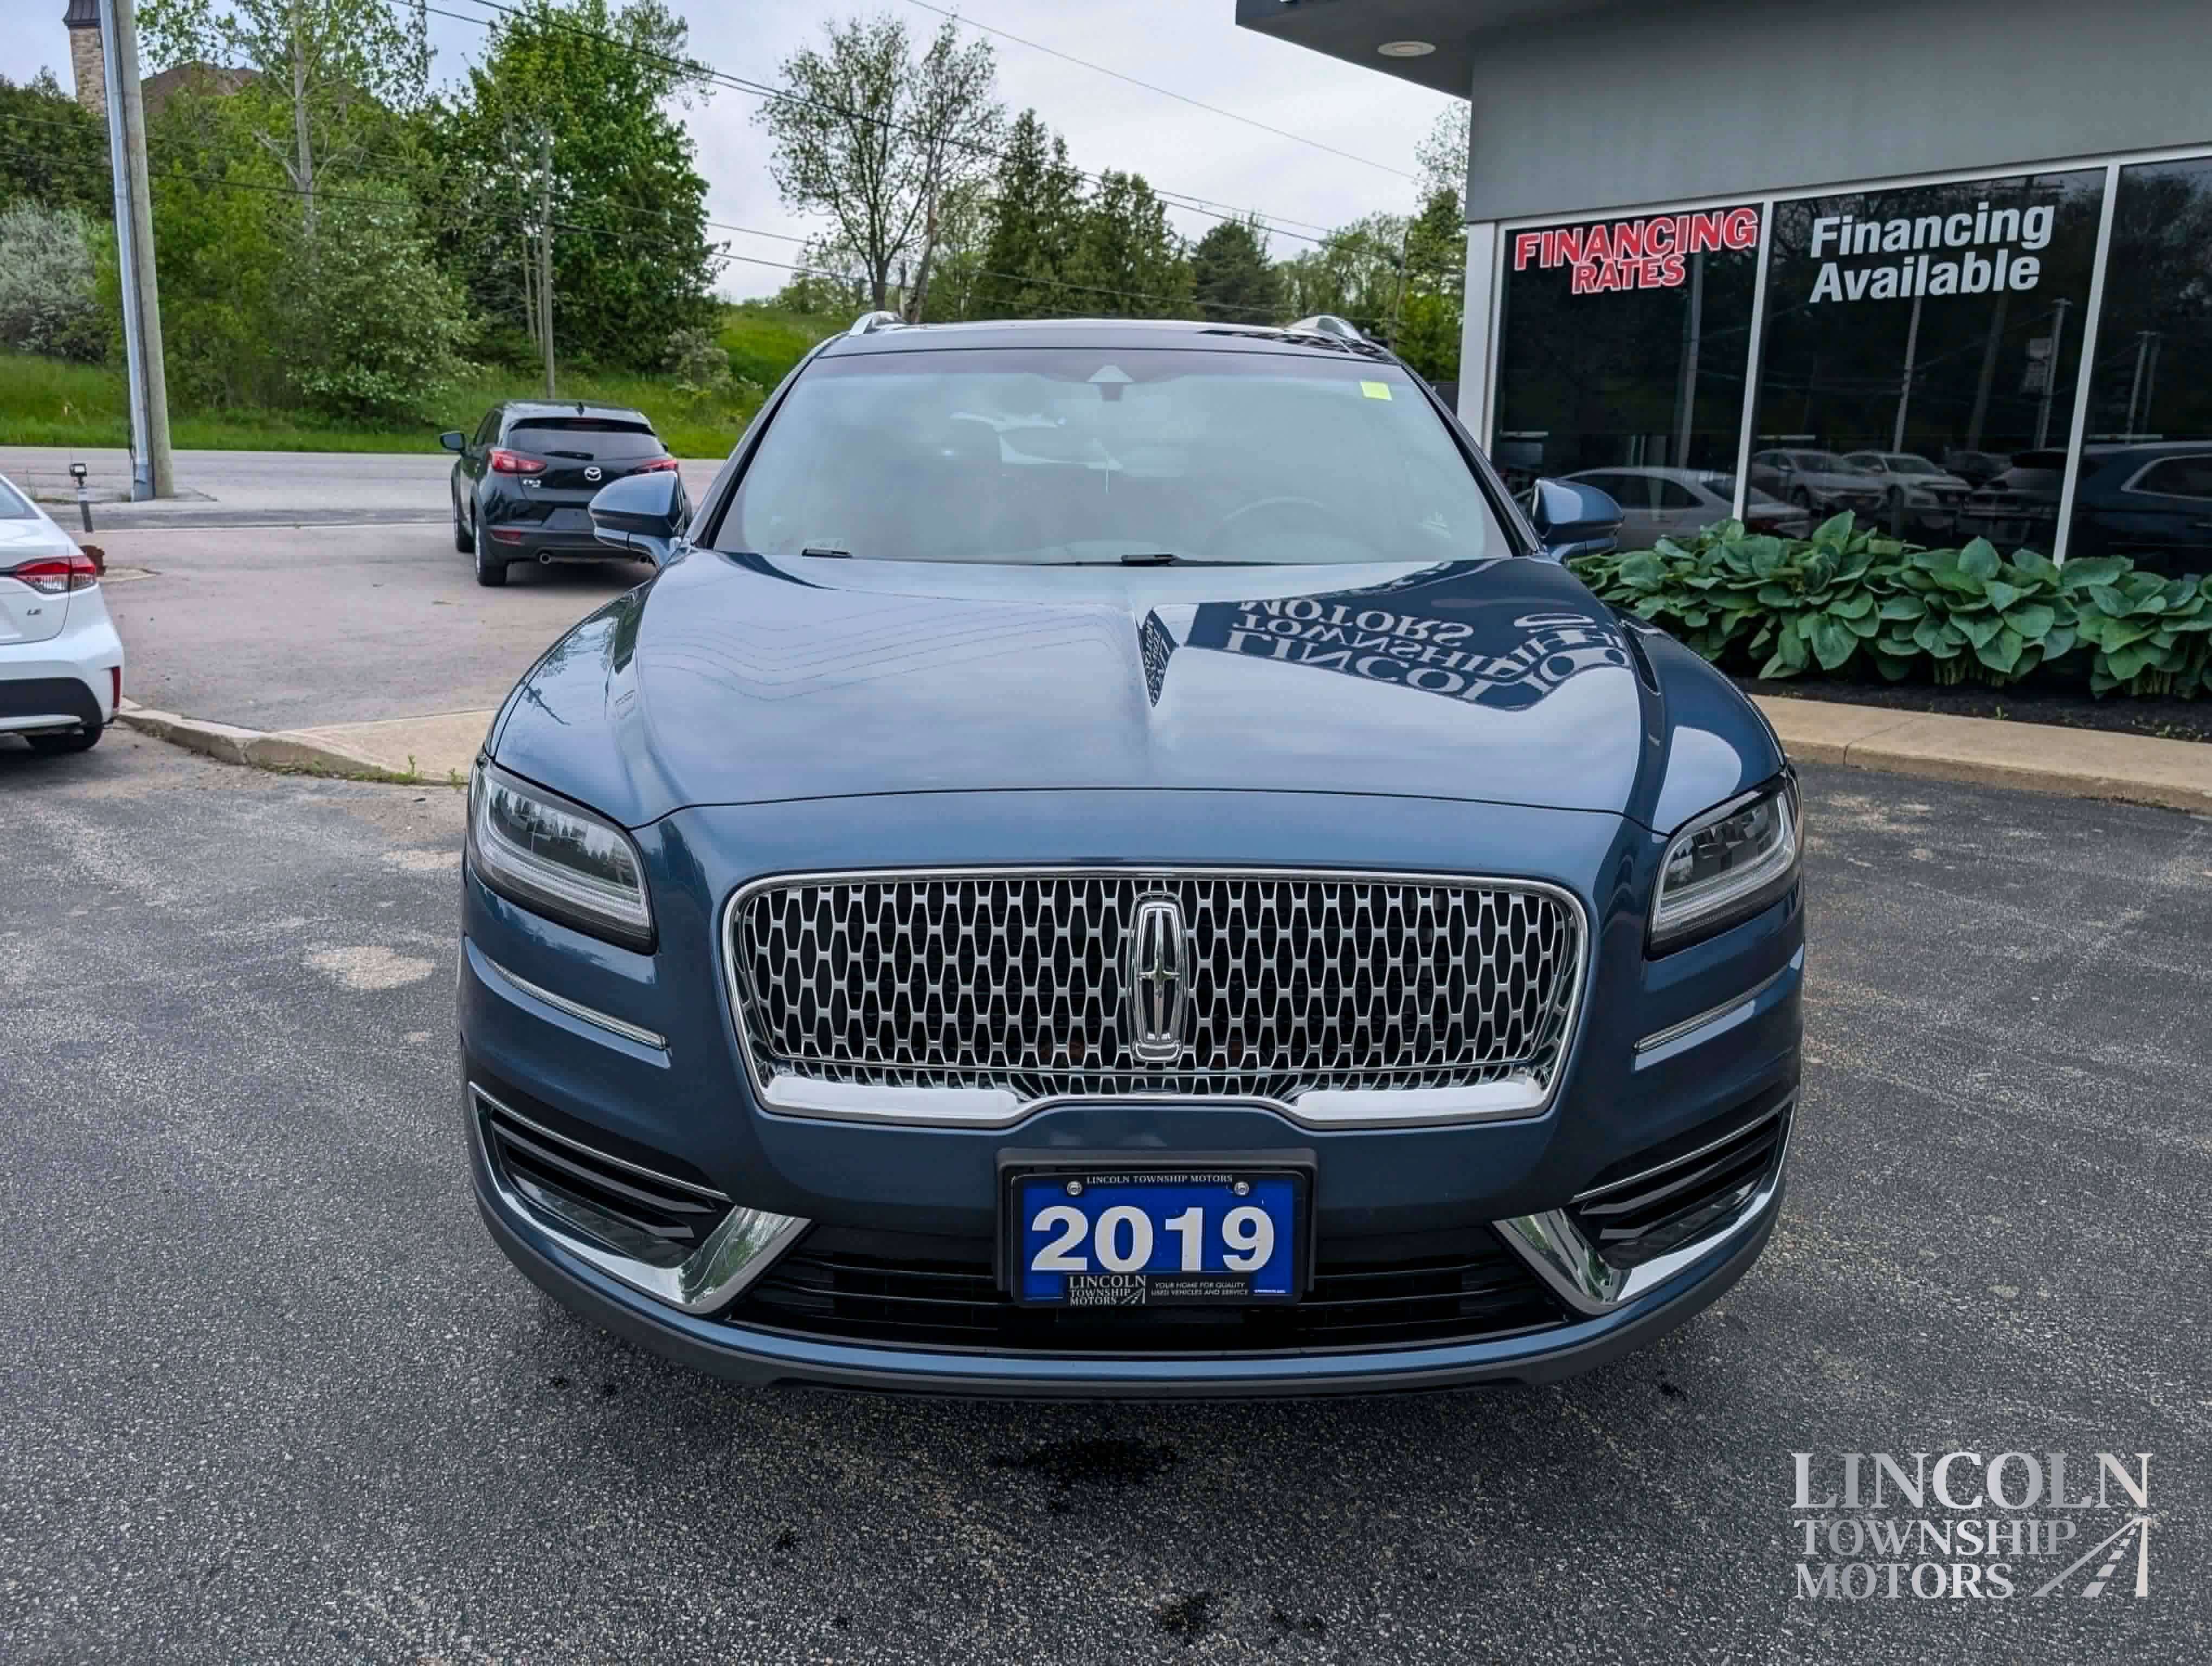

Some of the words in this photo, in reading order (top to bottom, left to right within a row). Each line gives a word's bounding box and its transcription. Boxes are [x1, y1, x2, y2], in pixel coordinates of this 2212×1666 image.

[1514, 208, 1758, 271] FINANCING
[1810, 202, 2055, 259] Financing
[1572, 254, 1686, 295] RATES
[1809, 248, 2040, 304] Available
[1086, 1176, 1129, 1184] LINCOLN
[1134, 1175, 1188, 1183] TOWNSHIP
[1191, 1175, 1232, 1183] MOTORS
[1031, 1206, 1274, 1272] 2019
[1069, 1276, 1146, 1289] LINCOLN
[1069, 1288, 1131, 1297] TOWNSHIP
[1070, 1297, 1117, 1306] MOTORS
